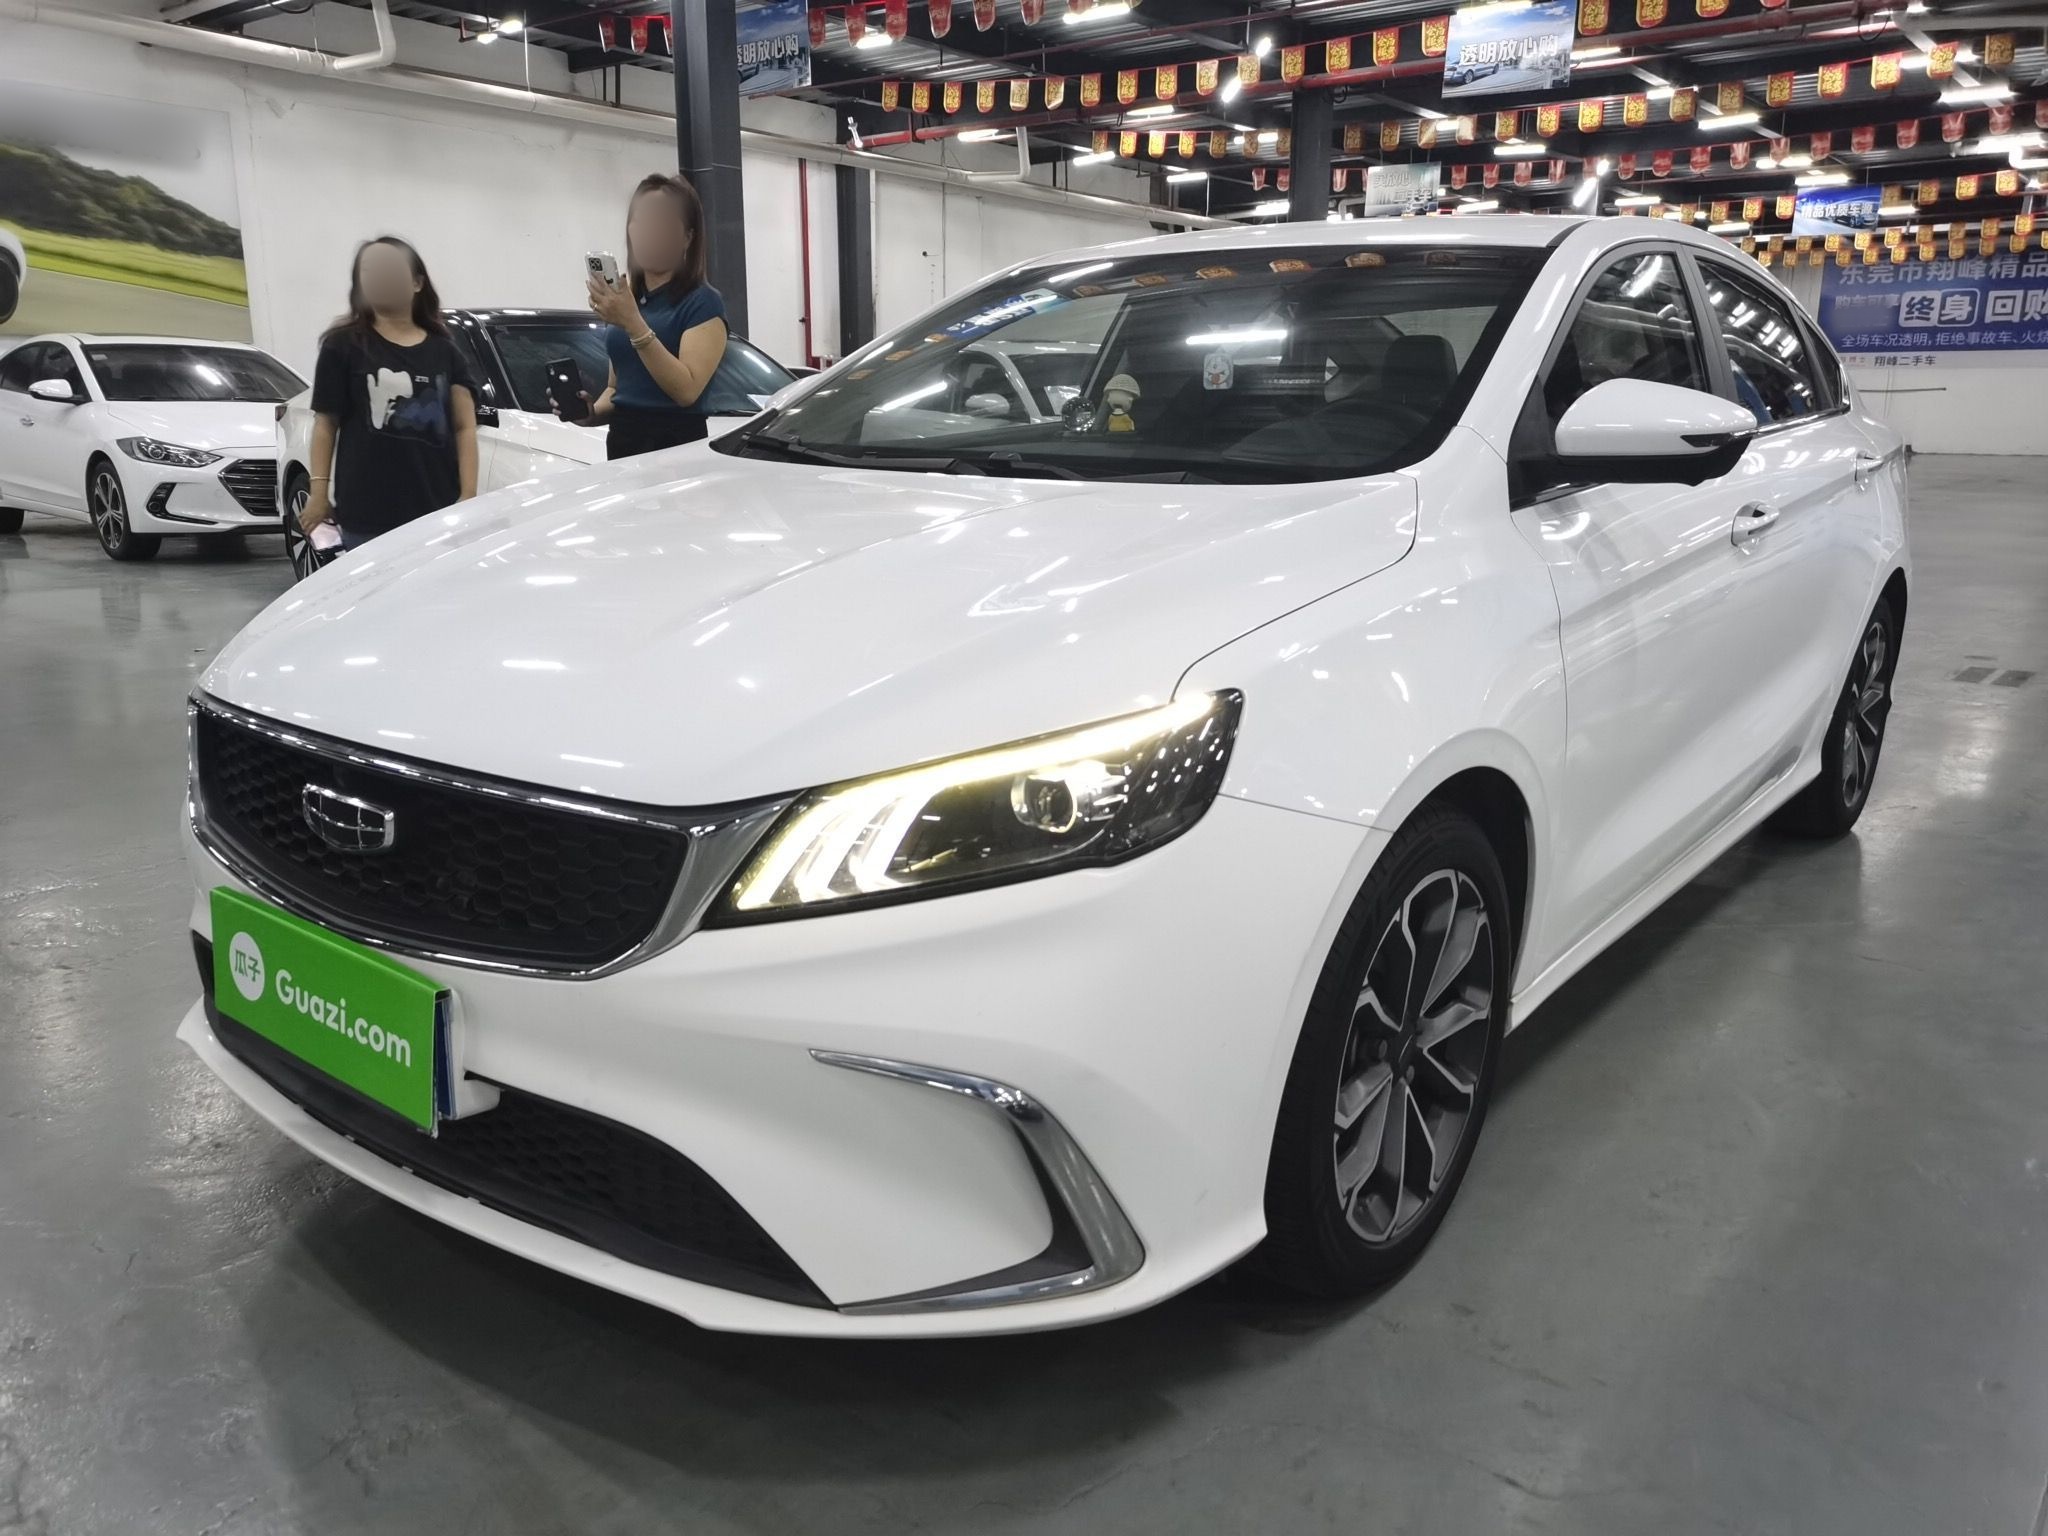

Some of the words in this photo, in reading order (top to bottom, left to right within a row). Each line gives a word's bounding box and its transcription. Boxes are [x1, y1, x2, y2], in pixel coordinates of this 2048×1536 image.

[1459, 35, 1559, 66] 透明放心购
[1874, 355, 1937, 367] 翔峰二手车
[234, 949, 261, 982] 瓜子
[275, 969, 411, 1067] Guazi.com
